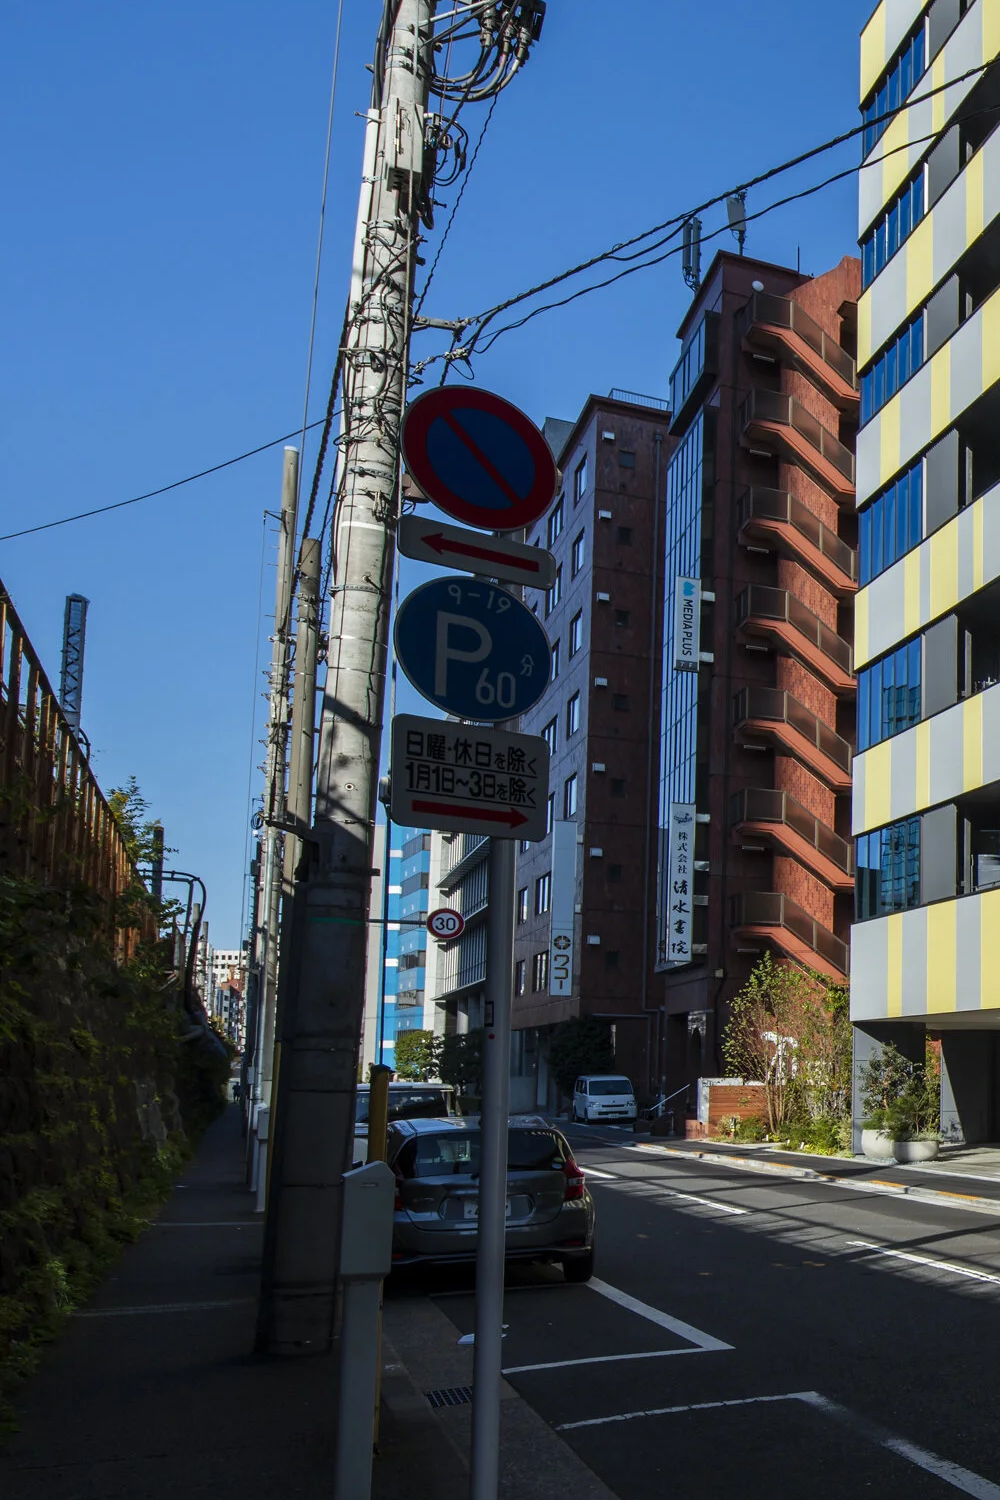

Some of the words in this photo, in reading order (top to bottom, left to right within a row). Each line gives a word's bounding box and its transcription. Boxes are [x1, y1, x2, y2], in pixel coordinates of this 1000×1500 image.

[435, 610, 493, 698] P
[435, 917, 456, 930] 30
[553, 954, 570, 990] ワコー
